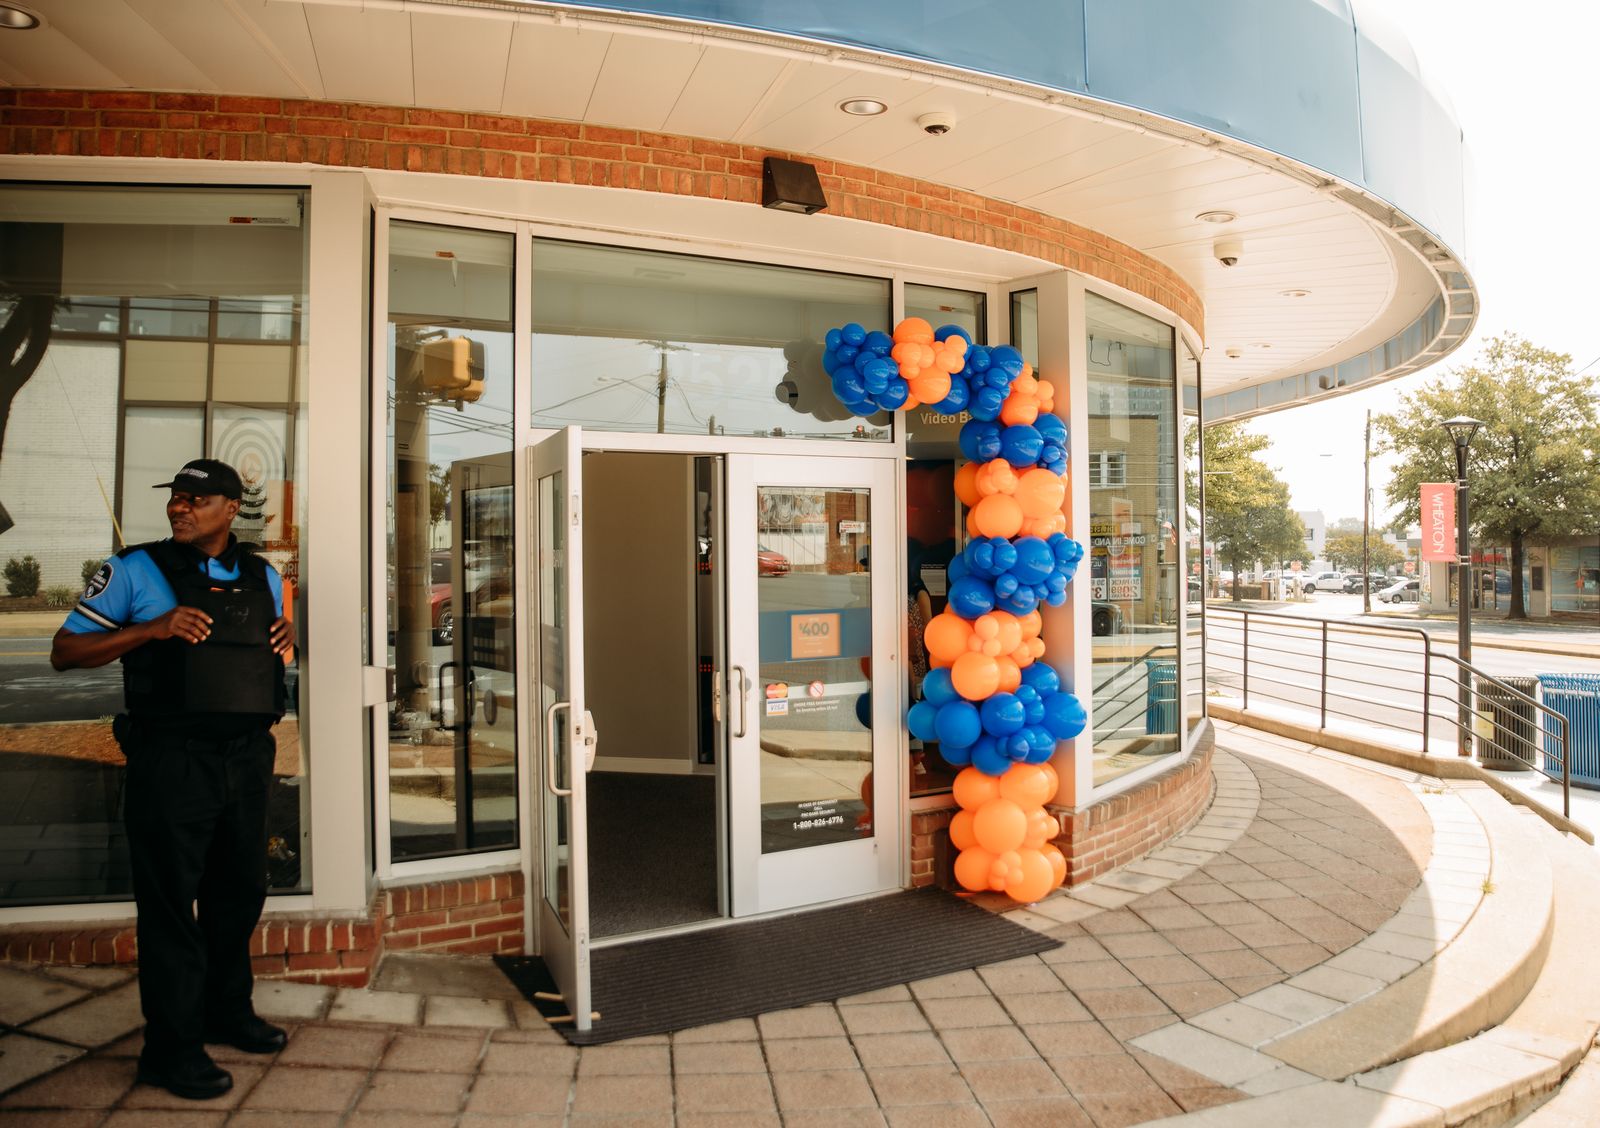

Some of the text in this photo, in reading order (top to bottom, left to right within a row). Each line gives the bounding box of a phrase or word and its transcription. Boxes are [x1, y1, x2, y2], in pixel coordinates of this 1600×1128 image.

[920, 412, 956, 424] Video
[1432, 492, 1445, 553] WHEATON
[771, 703, 785, 711] VISA
[793, 816, 843, 831] 1-800-826-6776
